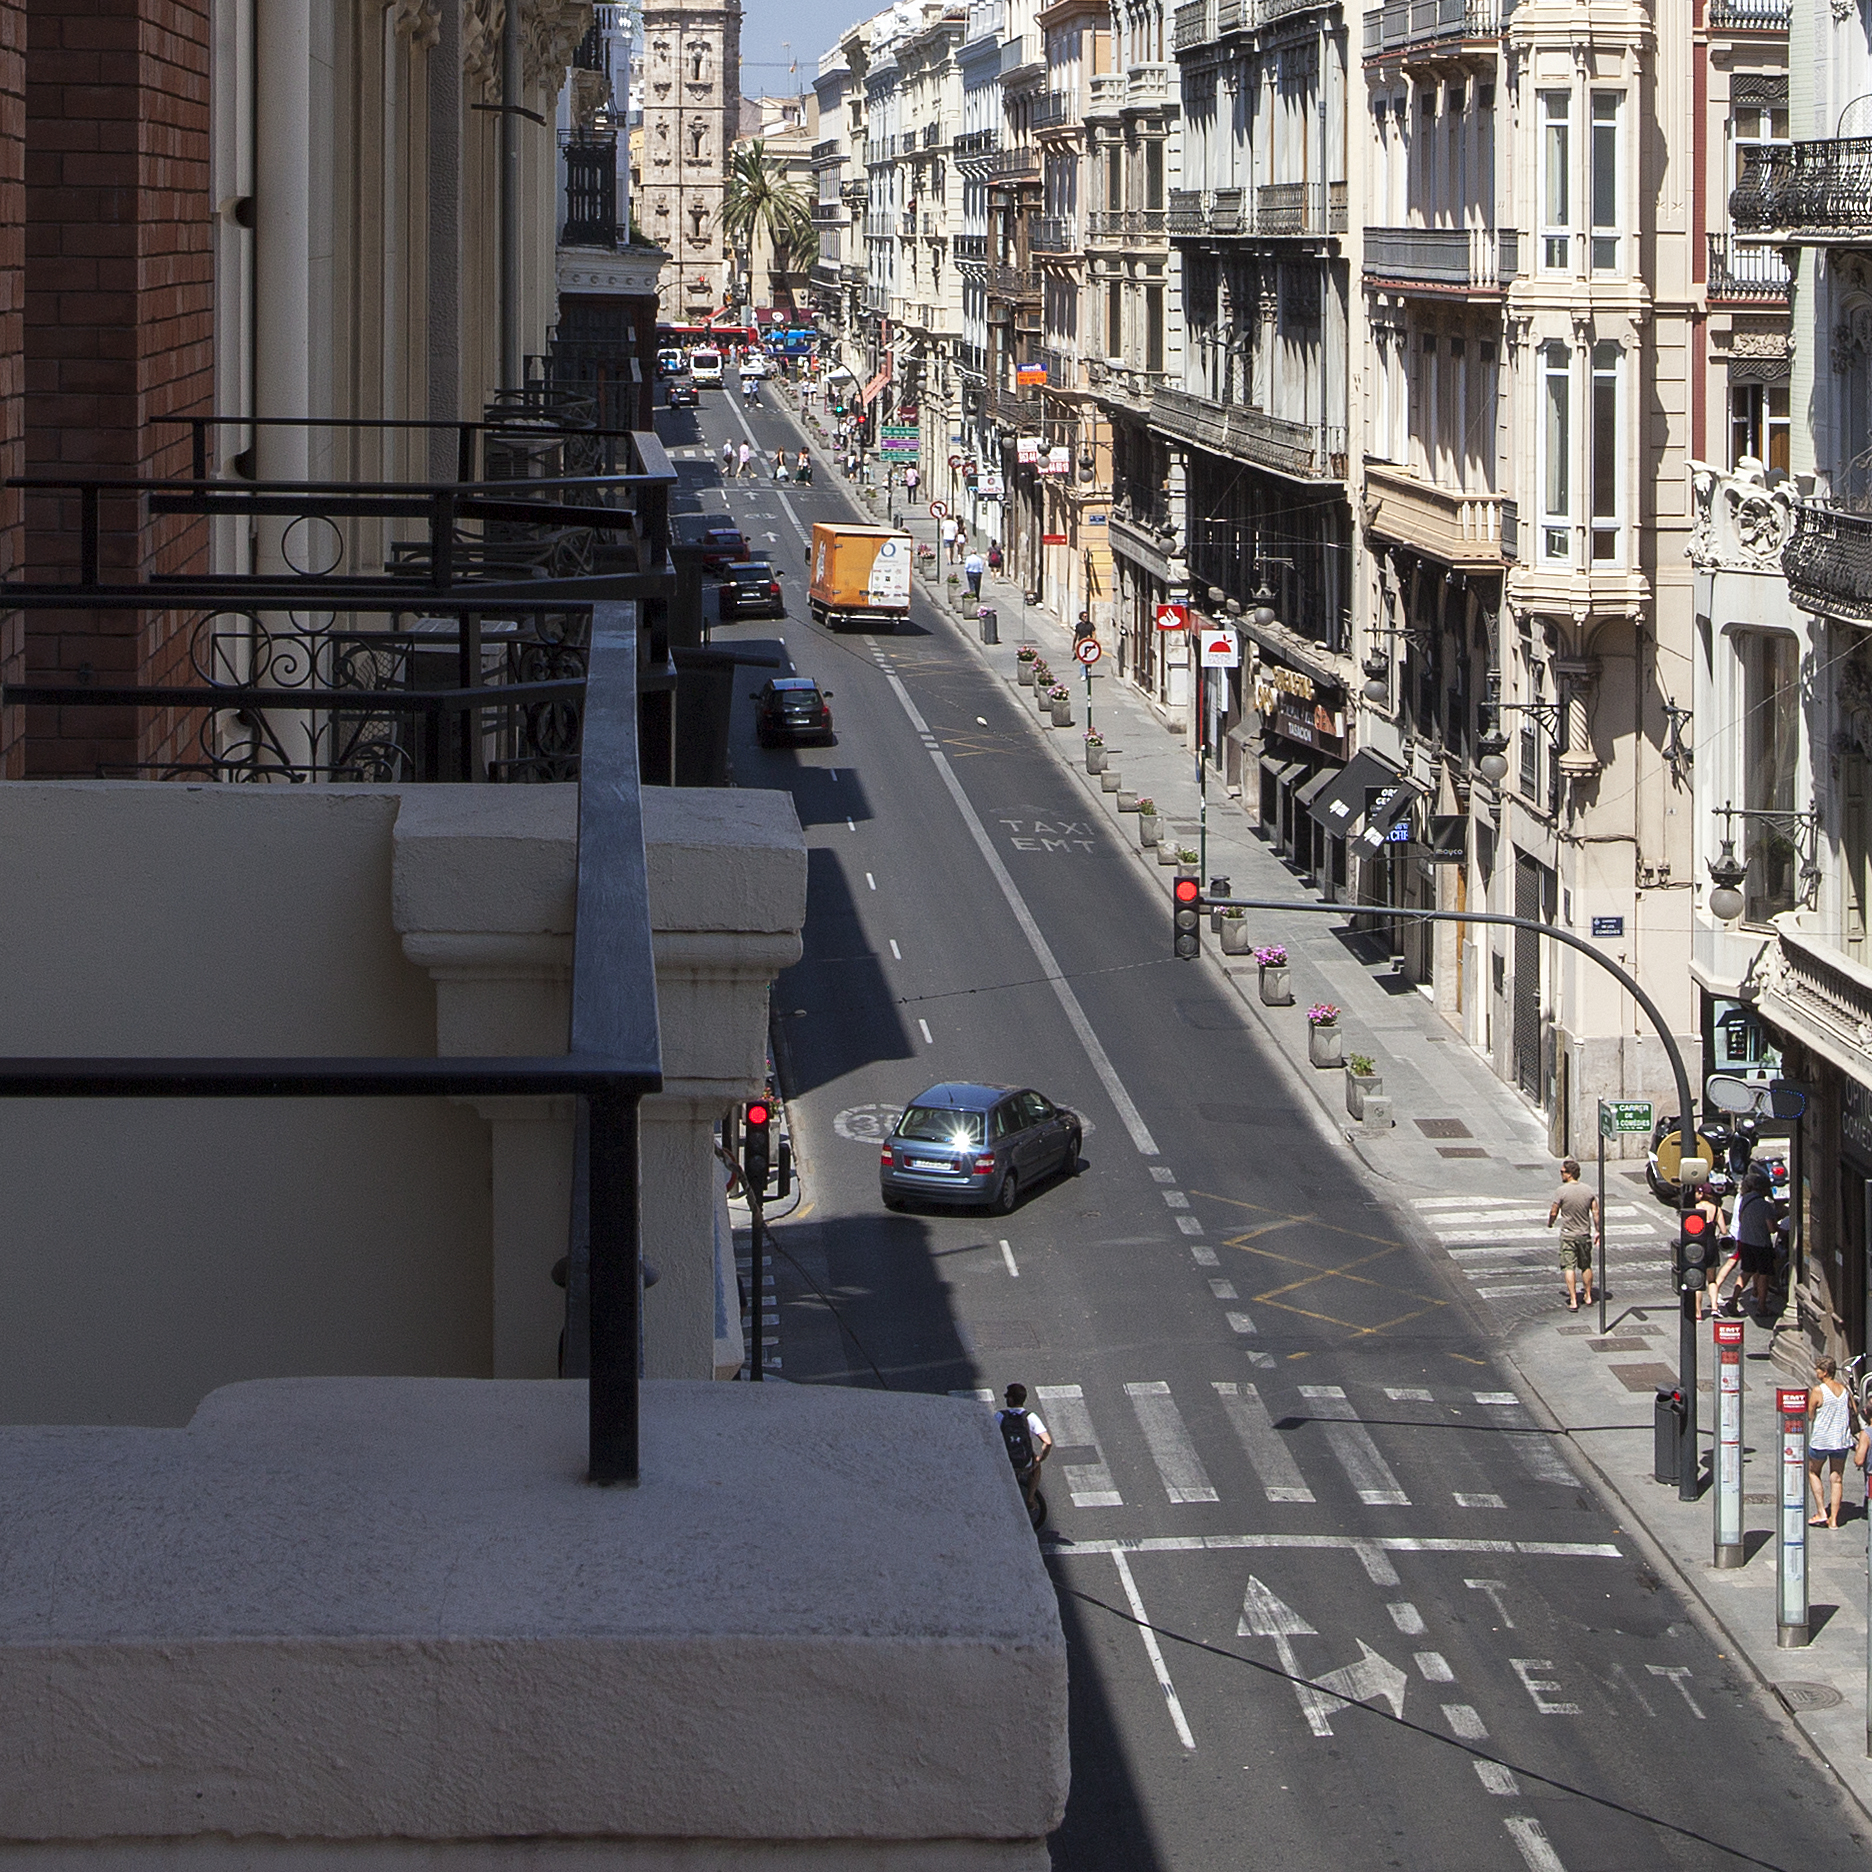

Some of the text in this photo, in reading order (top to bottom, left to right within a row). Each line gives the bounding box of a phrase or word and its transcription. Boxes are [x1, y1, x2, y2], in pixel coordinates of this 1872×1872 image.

[999, 820, 1095, 836] TAXI
[1010, 837, 1096, 854] EMT
[1619, 1104, 1649, 1112] CARRER
